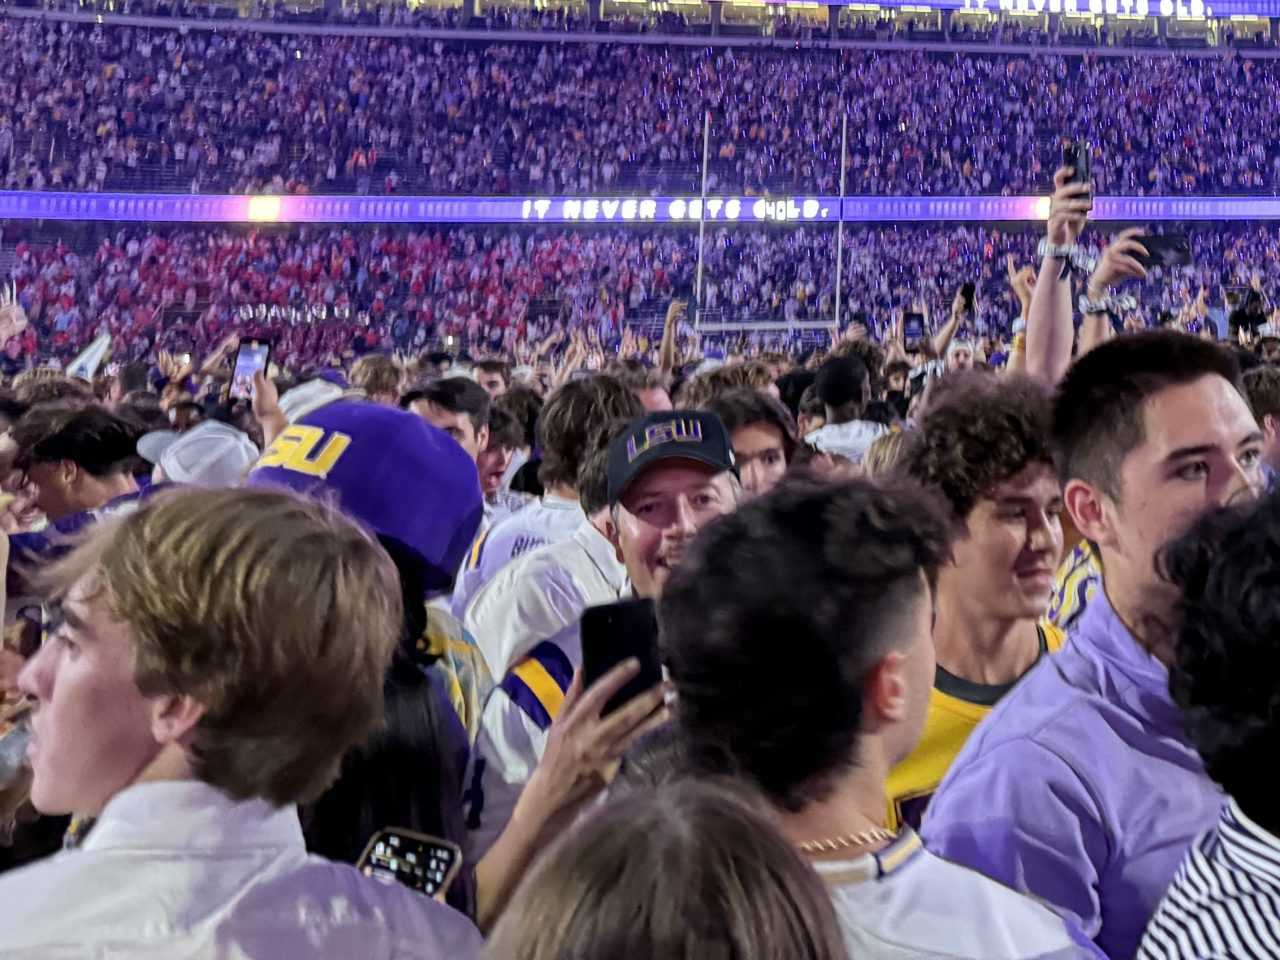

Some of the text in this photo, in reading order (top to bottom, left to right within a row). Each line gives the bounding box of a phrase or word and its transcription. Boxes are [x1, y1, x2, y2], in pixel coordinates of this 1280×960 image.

[522, 199, 551, 219] IT
[563, 199, 657, 219] NEVER
[668, 199, 741, 219] GETS
[626, 418, 703, 464] LSU
